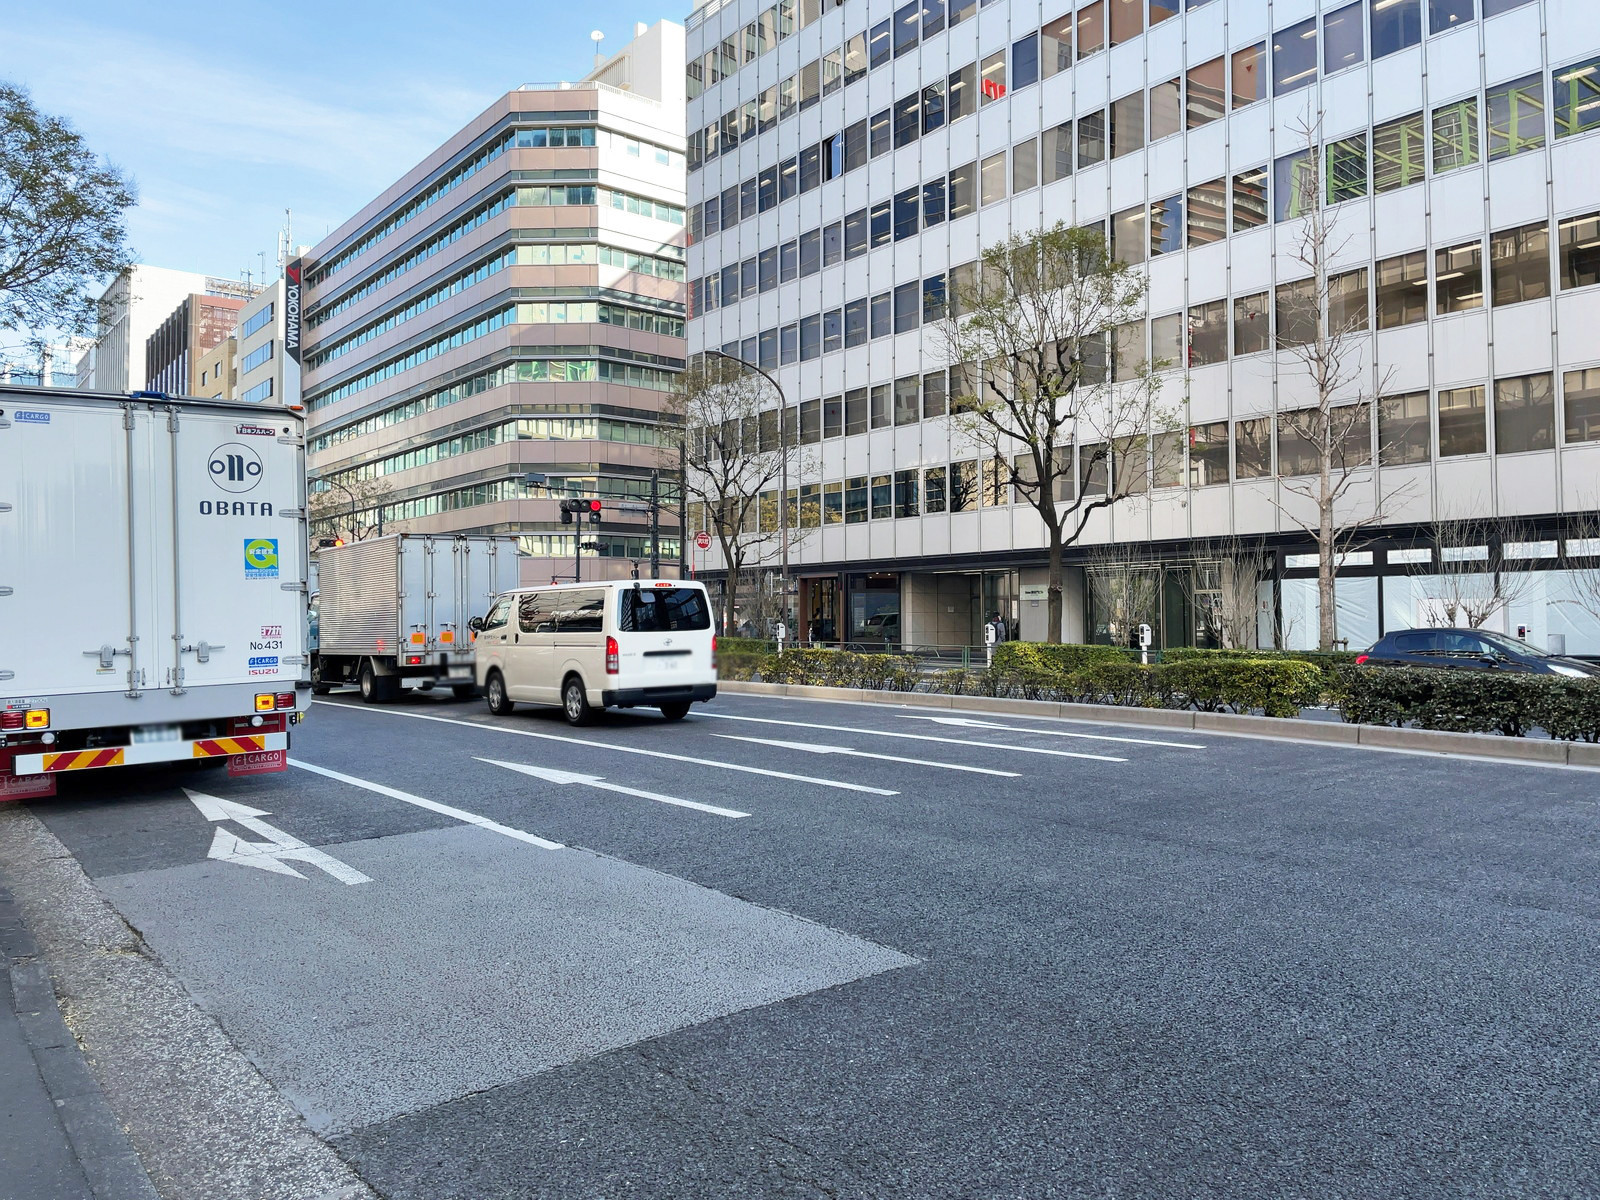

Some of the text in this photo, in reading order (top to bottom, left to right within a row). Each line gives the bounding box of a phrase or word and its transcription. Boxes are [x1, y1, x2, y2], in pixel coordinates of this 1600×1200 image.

[287, 284, 299, 349] YOKOHAMA
[199, 500, 273, 516] OBATA
[250, 640, 283, 650] No.431
